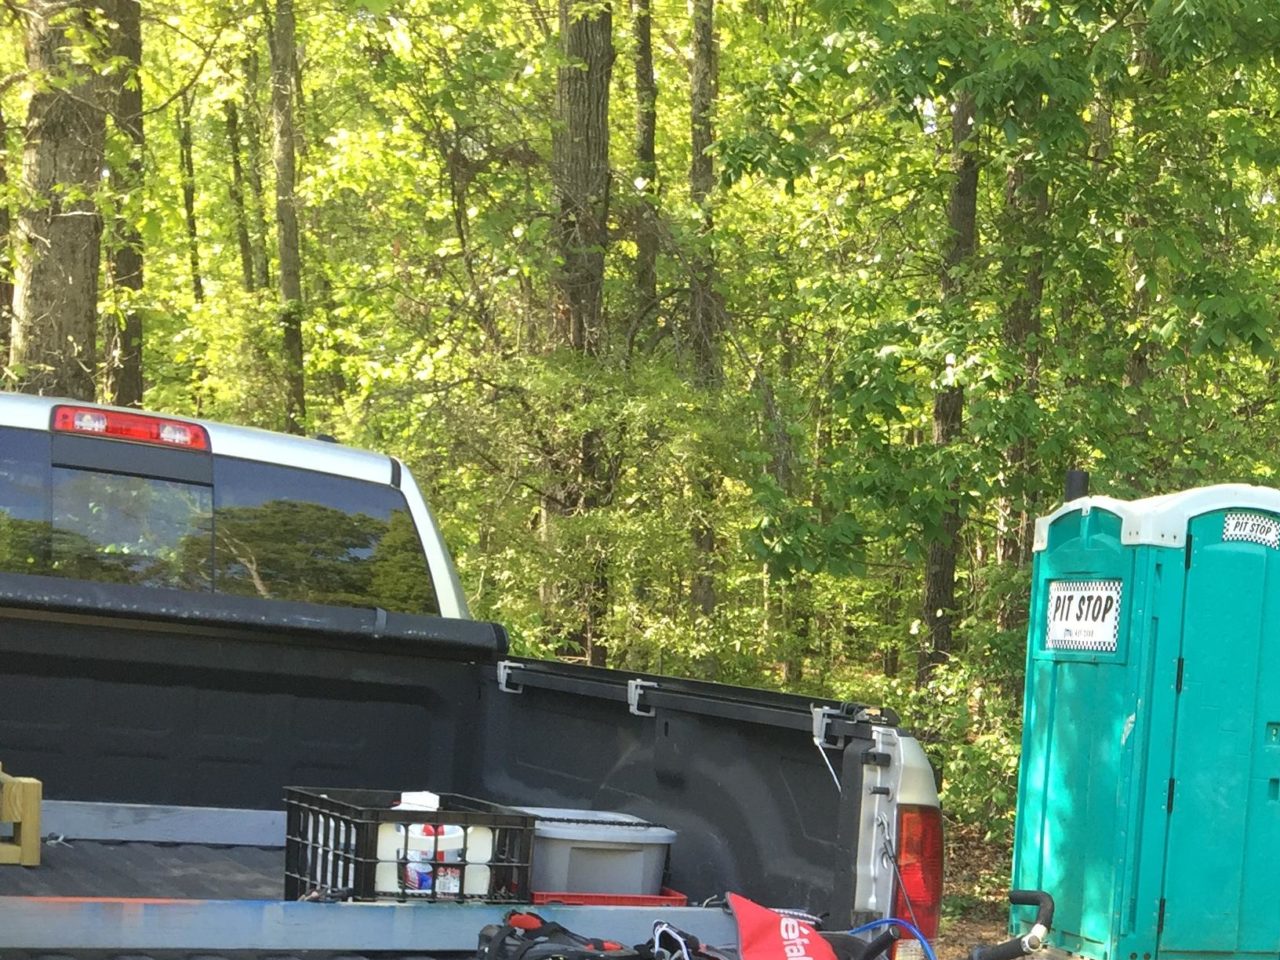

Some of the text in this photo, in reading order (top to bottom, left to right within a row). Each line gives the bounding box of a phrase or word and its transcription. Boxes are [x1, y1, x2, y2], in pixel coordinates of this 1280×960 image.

[1233, 521, 1272, 536] PIT STOP
[1053, 595, 1114, 622] PIT STOP
